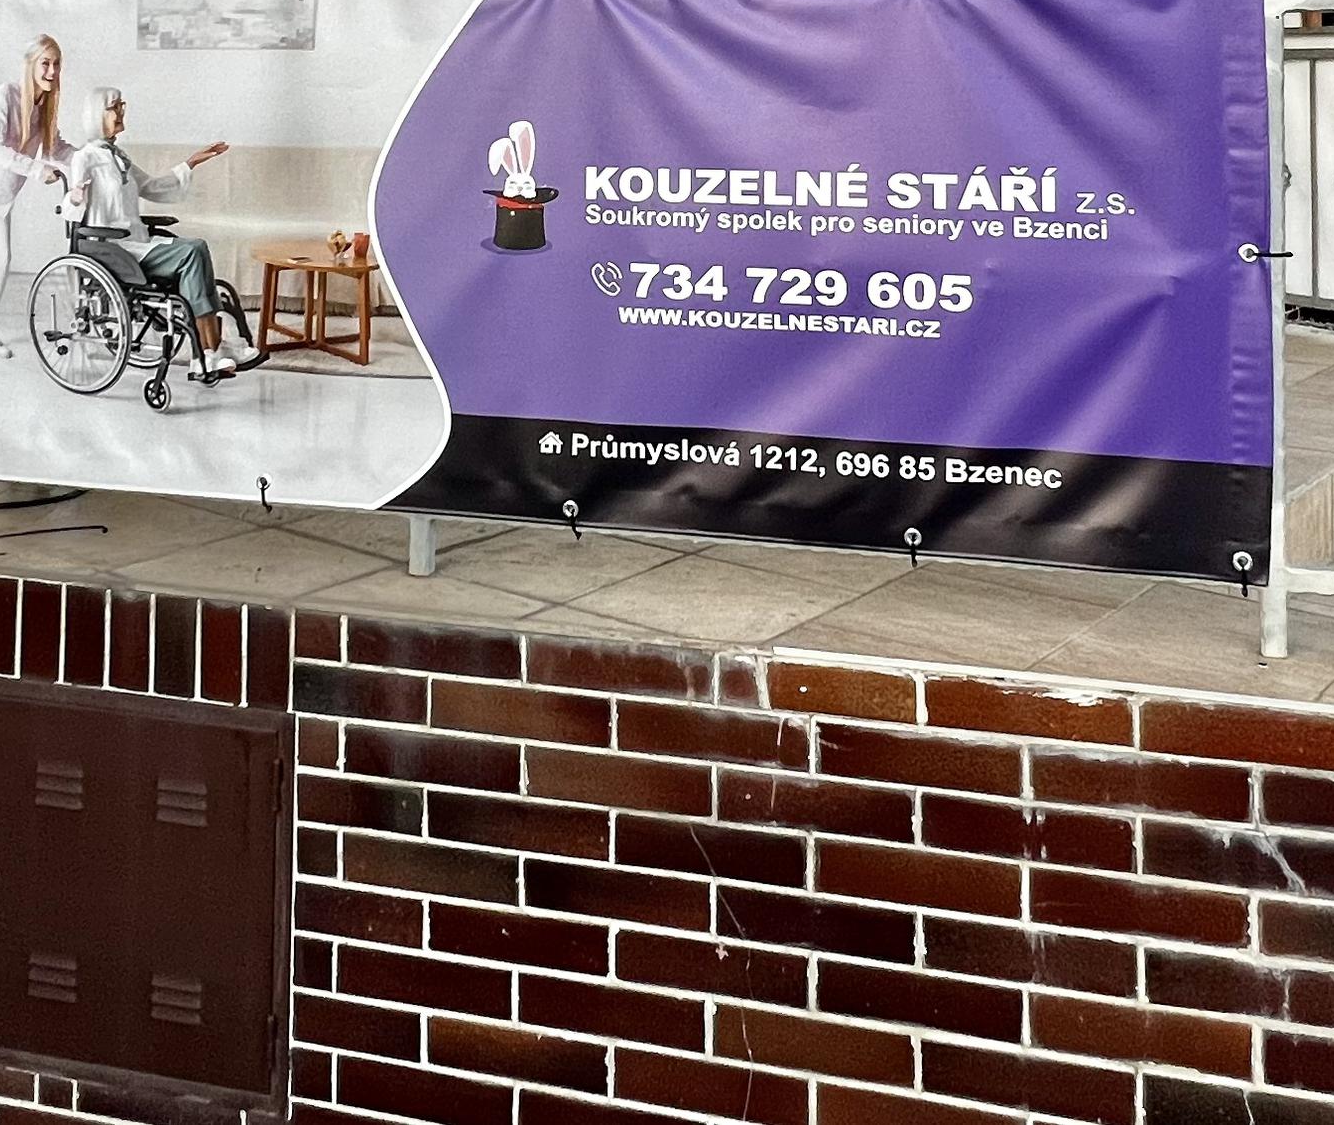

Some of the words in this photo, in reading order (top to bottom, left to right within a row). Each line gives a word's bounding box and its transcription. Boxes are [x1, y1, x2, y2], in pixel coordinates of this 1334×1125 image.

[584, 163, 869, 209] KOUZELNÉ
[886, 166, 1058, 213] STÁŘÍ
[585, 203, 710, 233] Soukromý
[717, 209, 803, 234] spolek
[810, 214, 855, 236] pro
[862, 213, 964, 241] seniory
[970, 218, 1005, 237] ve
[1012, 215, 1108, 240] Bzenci
[628, 263, 728, 301] 734
[745, 267, 848, 306] 729
[866, 272, 973, 312] 605
[618, 306, 941, 339] WWW.KOUZELNESTARI.CZ
[570, 434, 741, 467] Průmyslová
[749, 445, 827, 479] 1212,
[835, 452, 891, 478] 696
[899, 455, 936, 481] 85
[945, 459, 1063, 490] Bzenec
